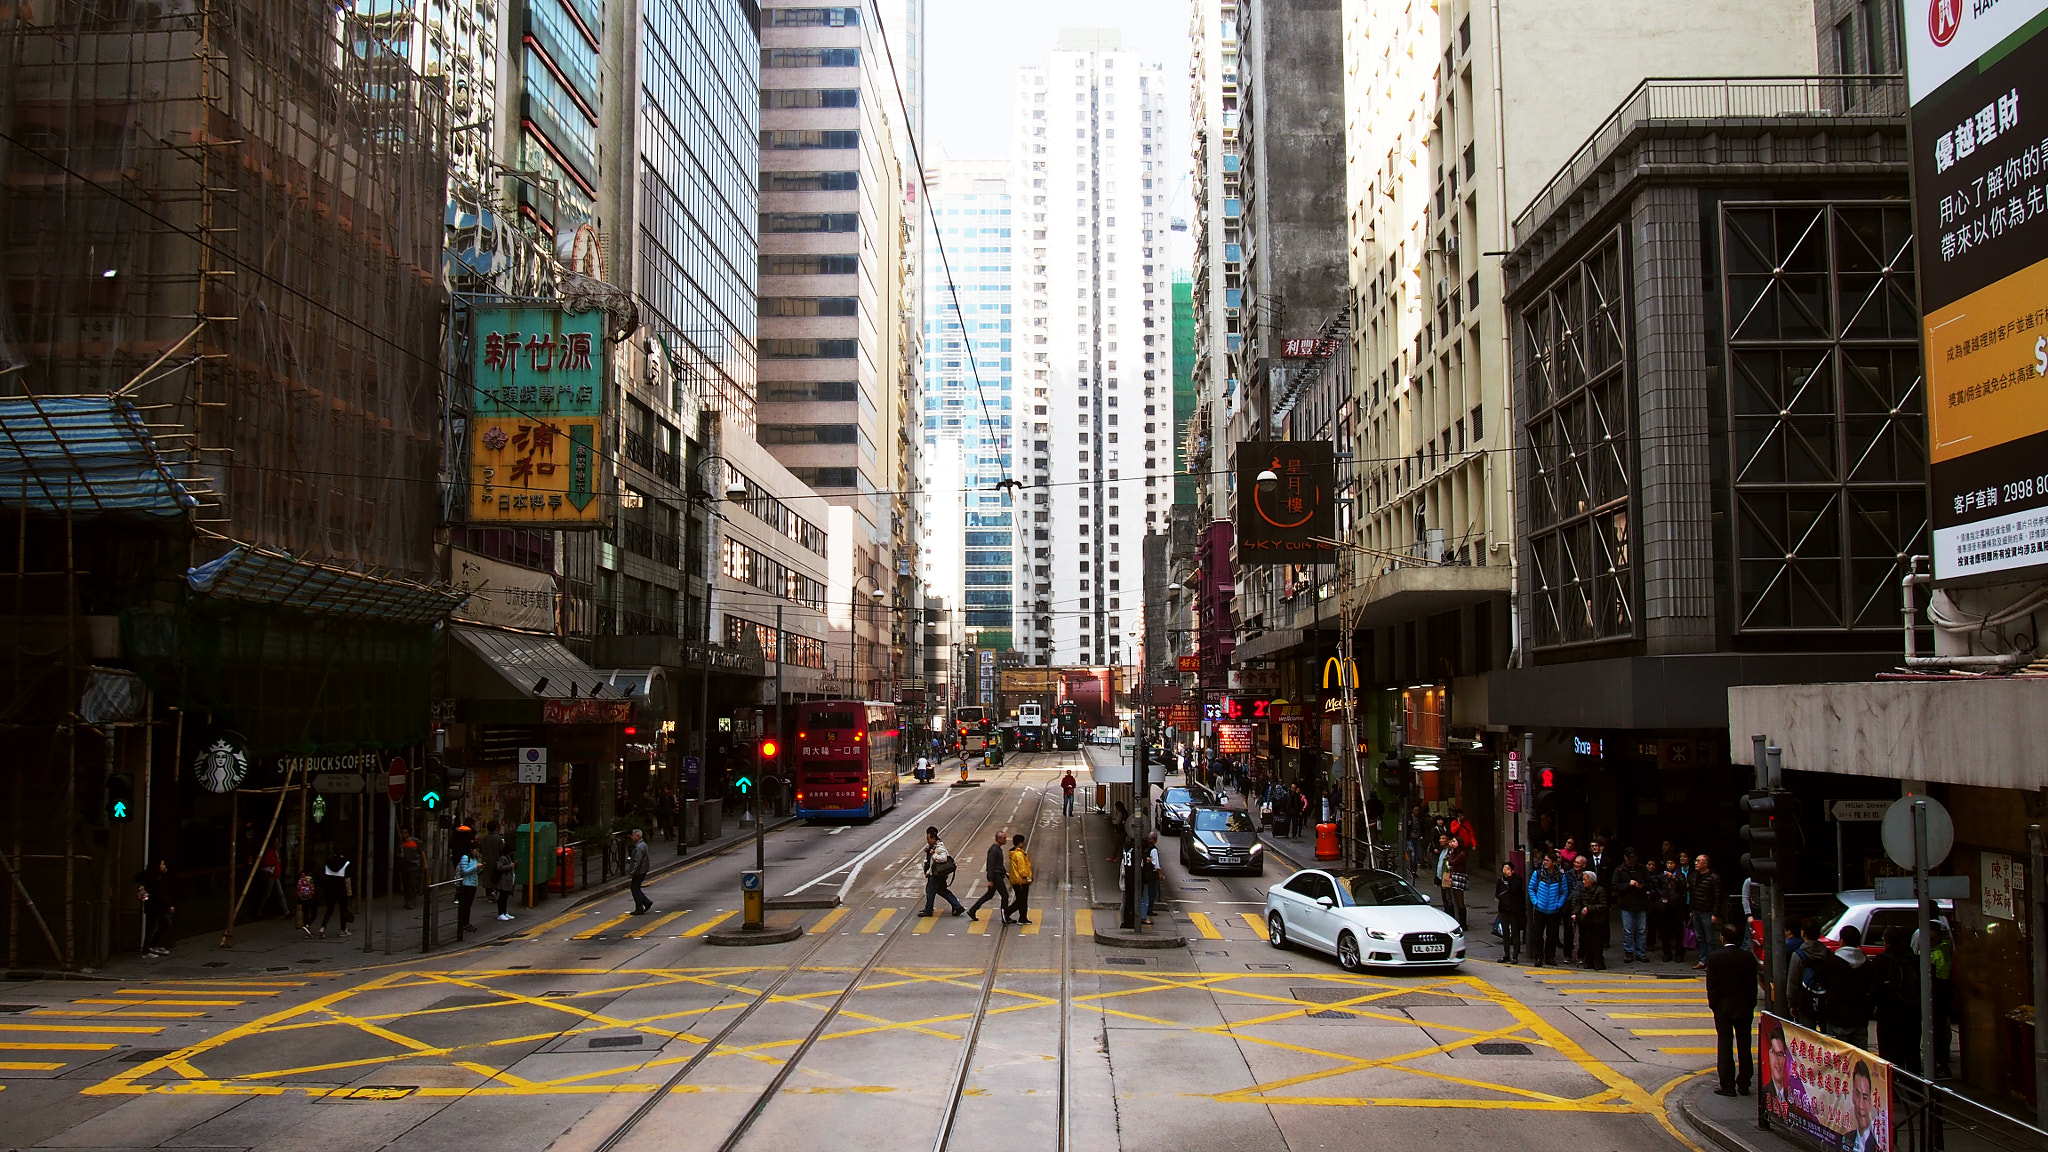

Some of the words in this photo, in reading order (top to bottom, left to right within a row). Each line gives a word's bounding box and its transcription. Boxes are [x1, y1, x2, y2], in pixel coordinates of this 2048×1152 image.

[1935, 87, 2019, 175] 優越理財
[1941, 184, 2048, 262] 帶來以你為先
[484, 331, 593, 371] 新竹源
[498, 493, 563, 511] 日本料亭
[1283, 459, 1308, 514] 星月樓
[1953, 486, 1998, 515] 客戶查詢
[2003, 478, 2033, 503] 2998
[1244, 540, 1282, 550] SKY
[1286, 541, 1331, 551] CUISNE
[277, 755, 342, 774] STARBUCKS
[803, 746, 830, 756] 周大福
[834, 746, 861, 756] 一口價
